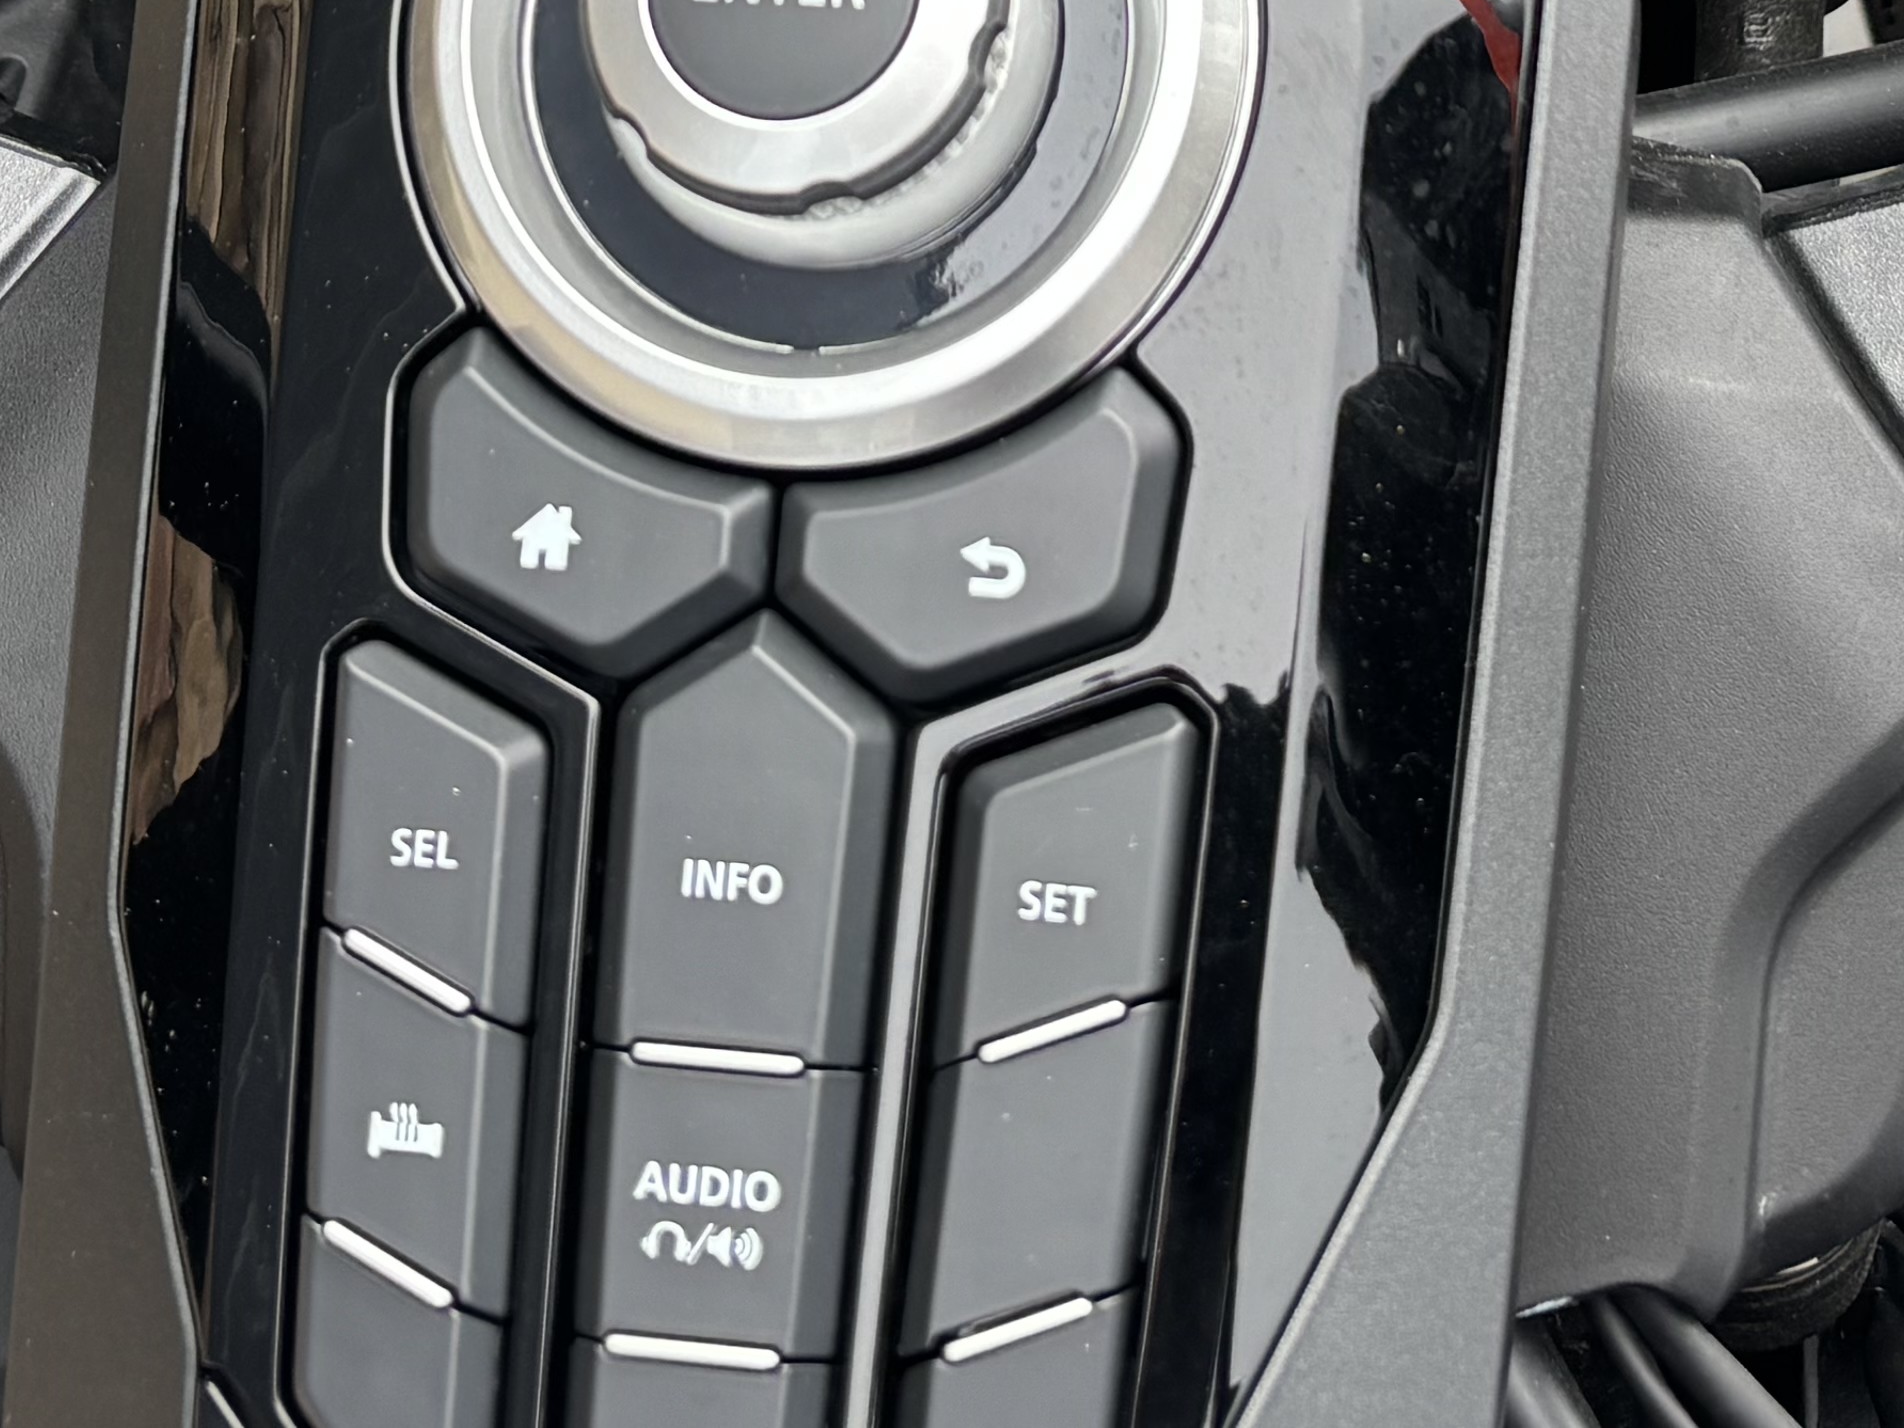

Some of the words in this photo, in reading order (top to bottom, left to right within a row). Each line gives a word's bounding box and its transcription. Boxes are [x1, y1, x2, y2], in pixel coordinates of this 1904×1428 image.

[390, 828, 458, 869] SEL
[681, 859, 783, 904] INFO
[1018, 881, 1097, 925] SET
[633, 1161, 781, 1212] AUDIO
